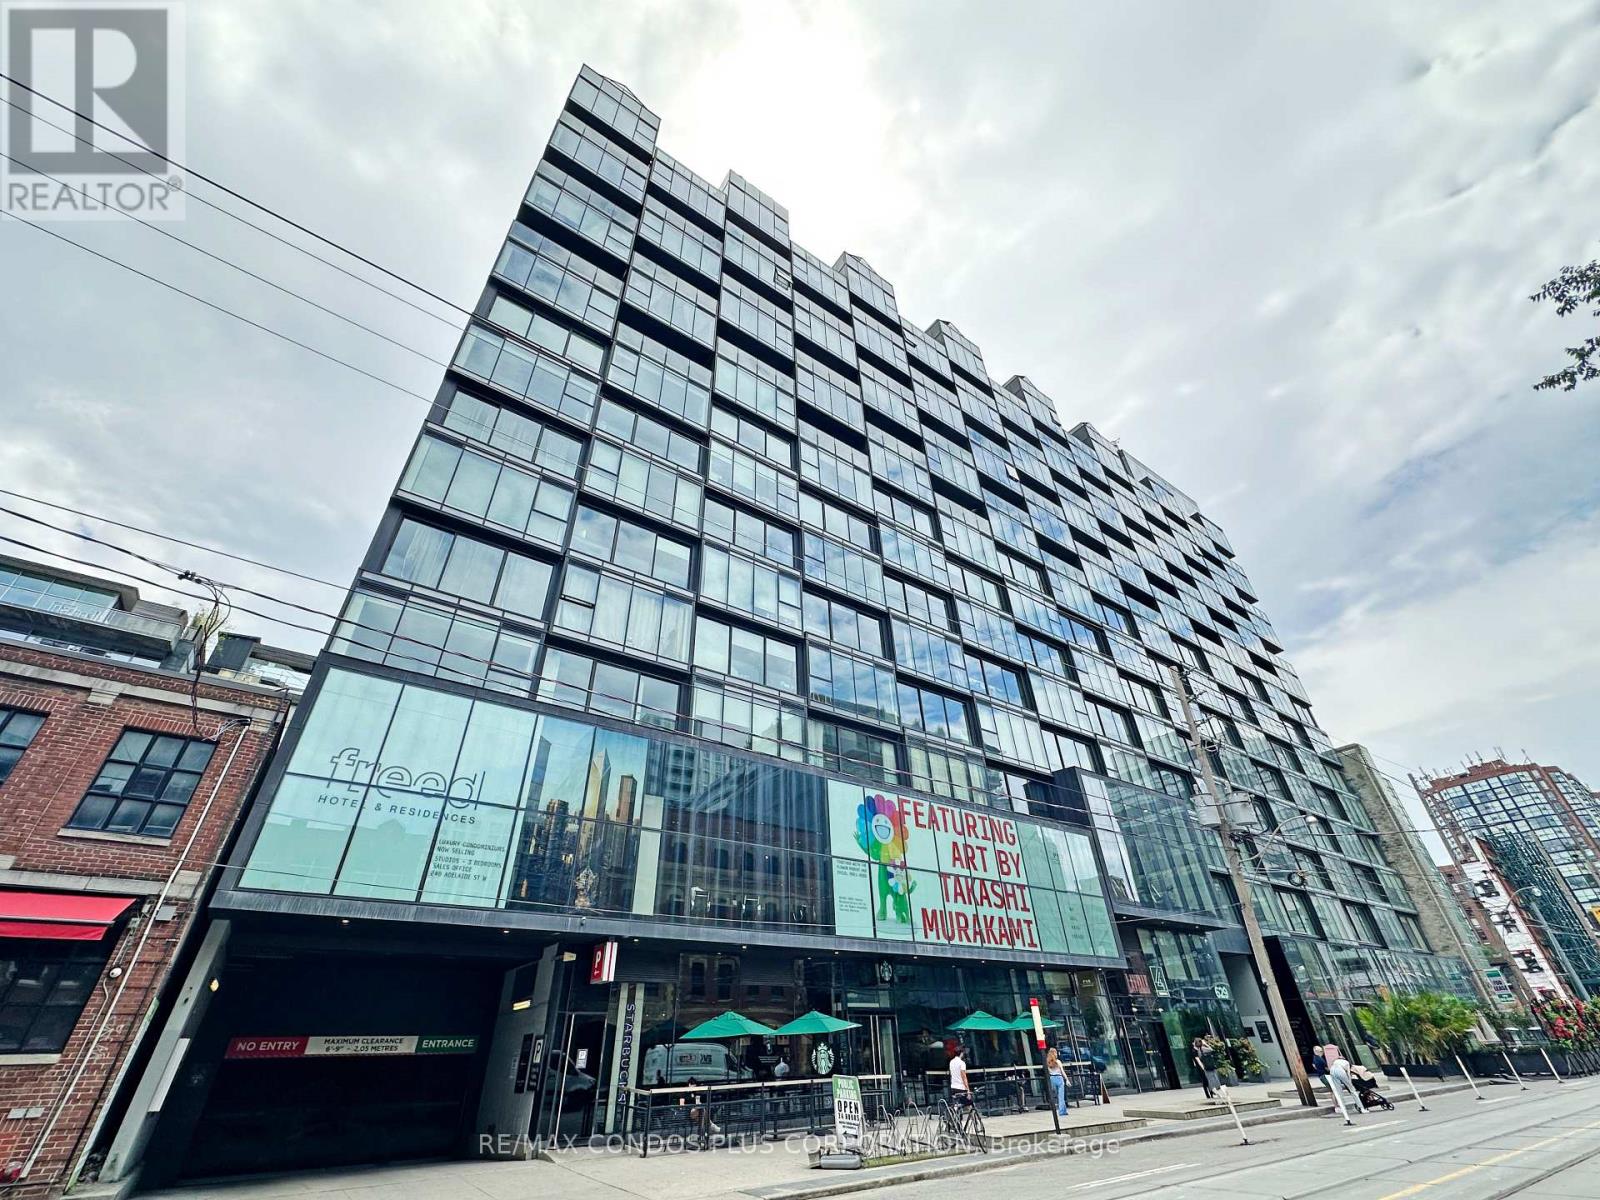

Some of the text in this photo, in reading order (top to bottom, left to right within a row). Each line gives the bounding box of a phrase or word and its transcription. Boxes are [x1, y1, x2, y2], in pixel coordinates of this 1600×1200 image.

[327, 747, 486, 810] freed
[374, 802, 382, 811] &
[389, 804, 476, 824] RESIDENCES
[898, 798, 1017, 846] FEATURING
[451, 847, 475, 855] SELLING
[433, 862, 472, 872] SALES OFFICE
[434, 856, 459, 864] STUDIOS
[951, 841, 1021, 878] ART BY
[938, 872, 1031, 913] TAKASHI
[920, 907, 1038, 948] MURAKAMI
[594, 950, 602, 968] P
[1214, 986, 1229, 999] 629
[236, 1042, 299, 1051] NO ENTRY
[421, 1039, 475, 1048] ENTRANCE
[837, 1100, 859, 1114] OPEN
